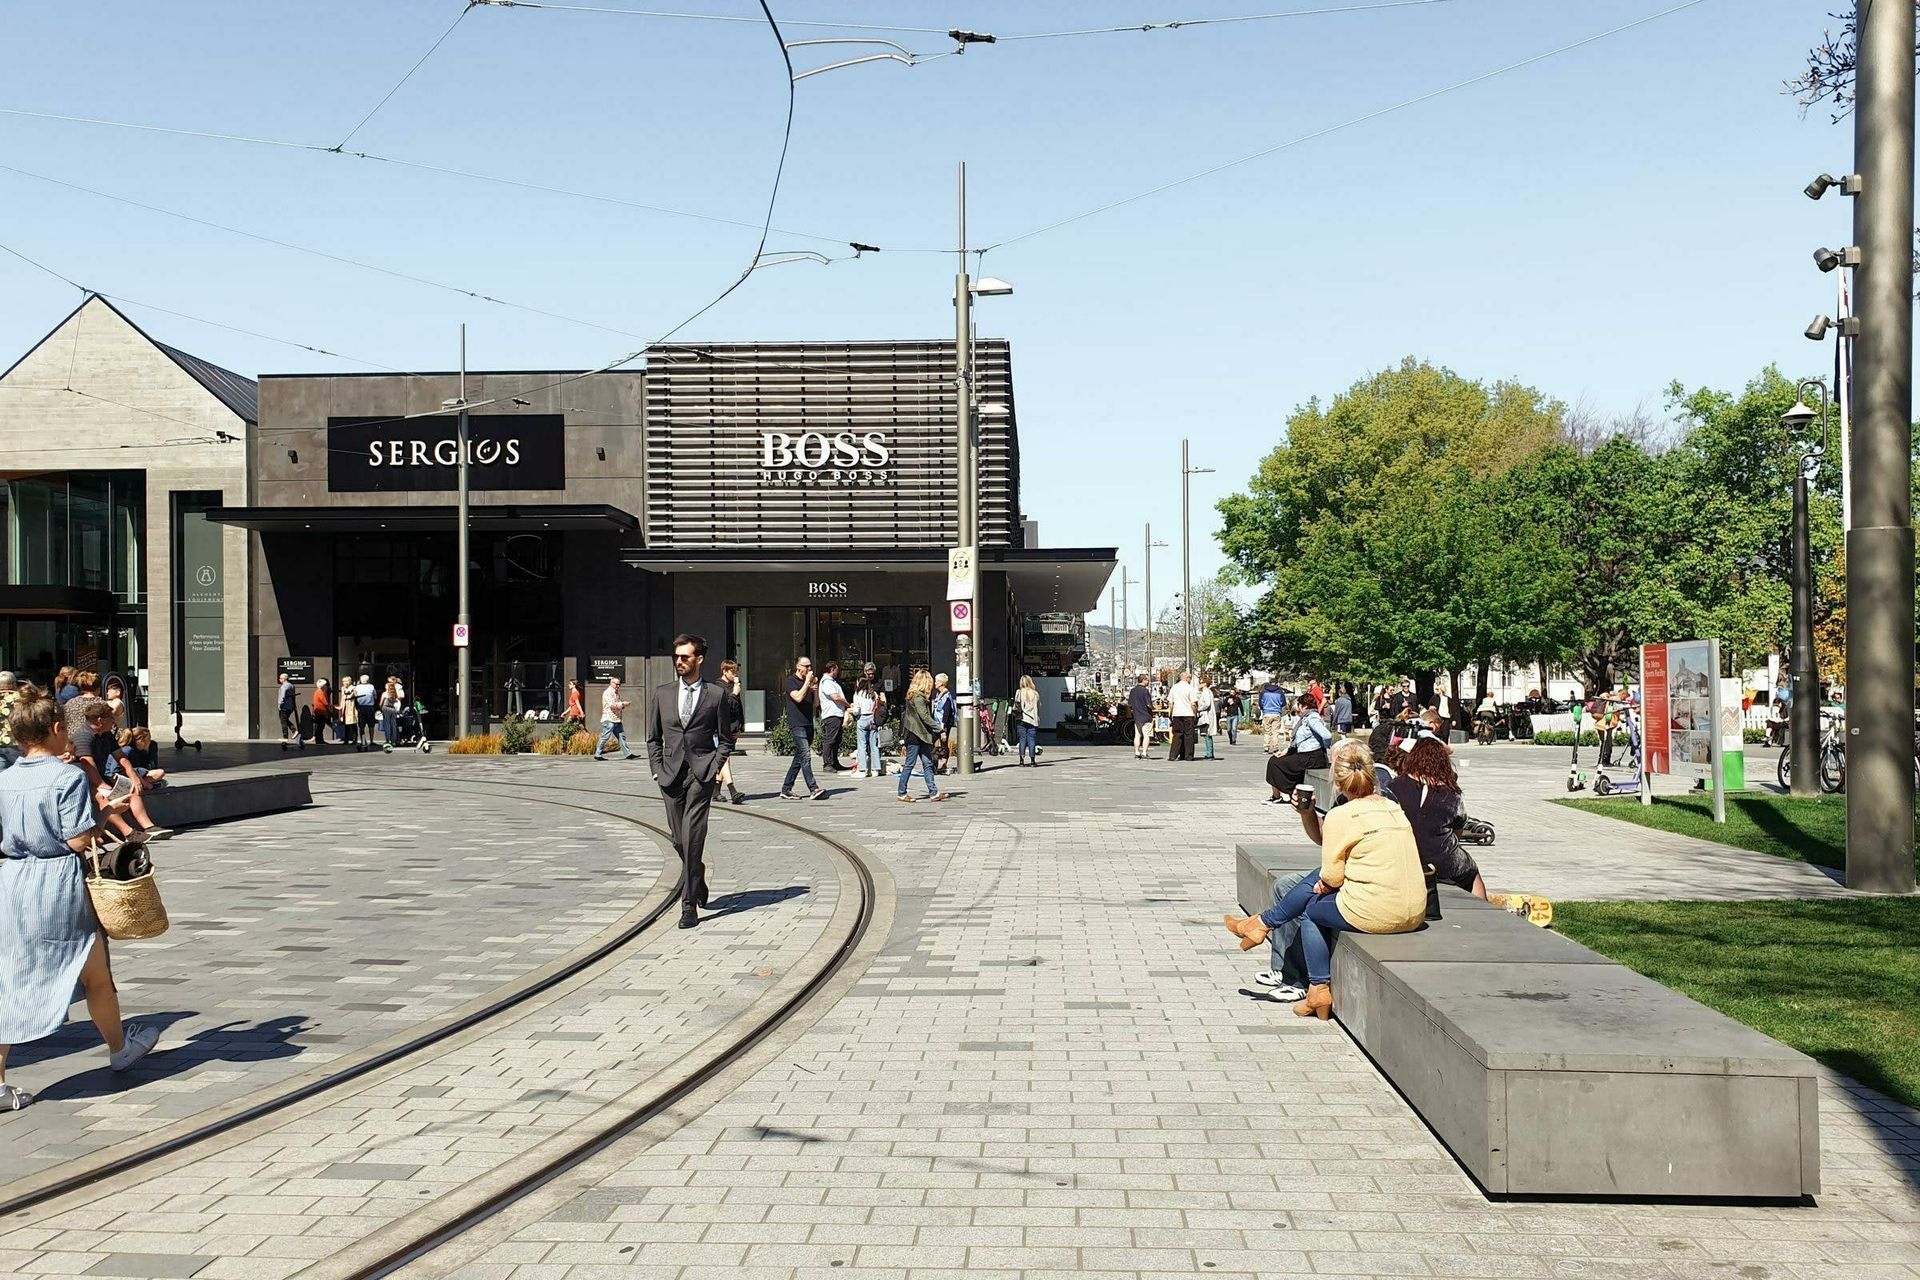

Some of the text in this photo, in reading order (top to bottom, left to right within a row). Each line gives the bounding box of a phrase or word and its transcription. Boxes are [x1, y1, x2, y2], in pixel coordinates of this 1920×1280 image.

[369, 438, 520, 467] SERGIOS
[761, 432, 889, 468] BOSS
[763, 471, 888, 480] HUGO BOSS
[809, 582, 847, 594] BOSS
